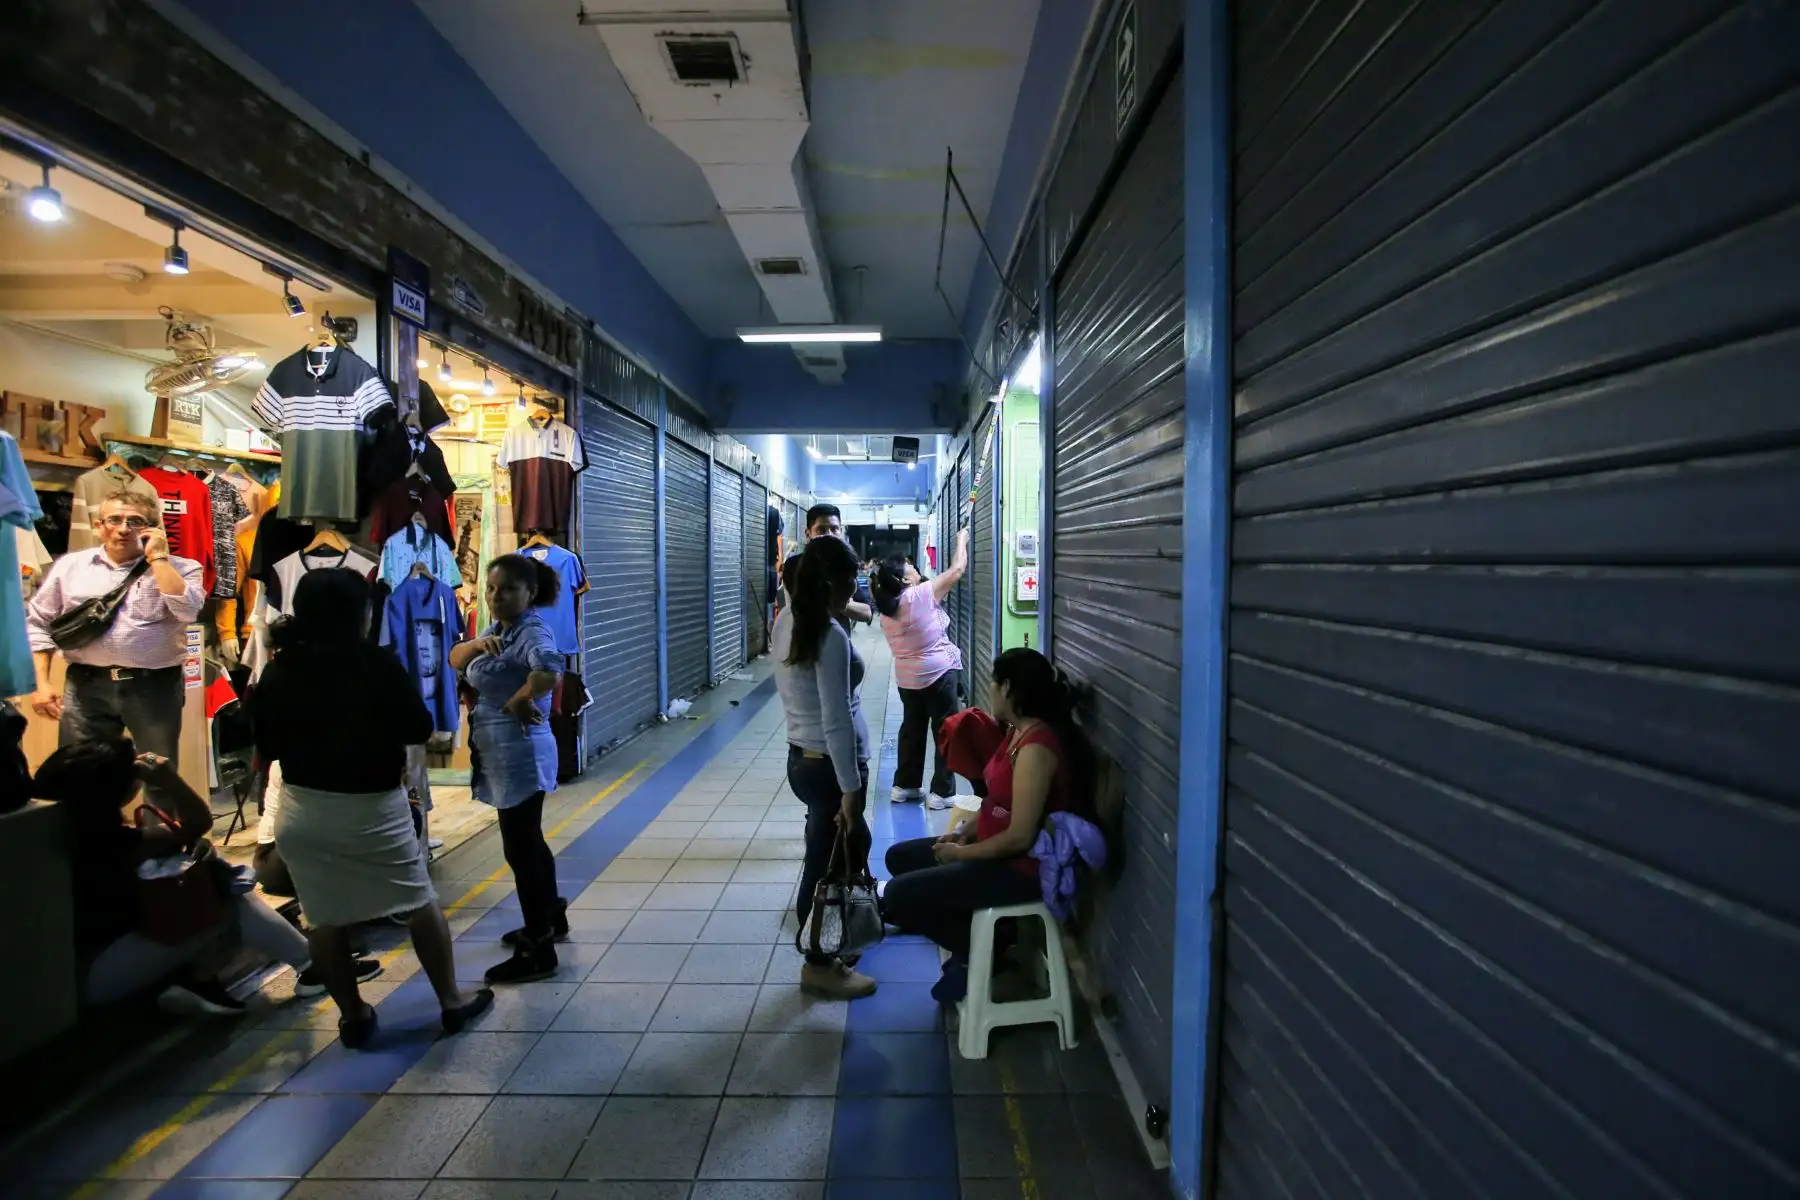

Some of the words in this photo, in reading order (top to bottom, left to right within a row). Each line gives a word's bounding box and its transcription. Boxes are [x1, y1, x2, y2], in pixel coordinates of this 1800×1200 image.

[398, 288, 421, 313] VISA
[174, 399, 200, 417] RTK
[0, 390, 106, 461] TK
